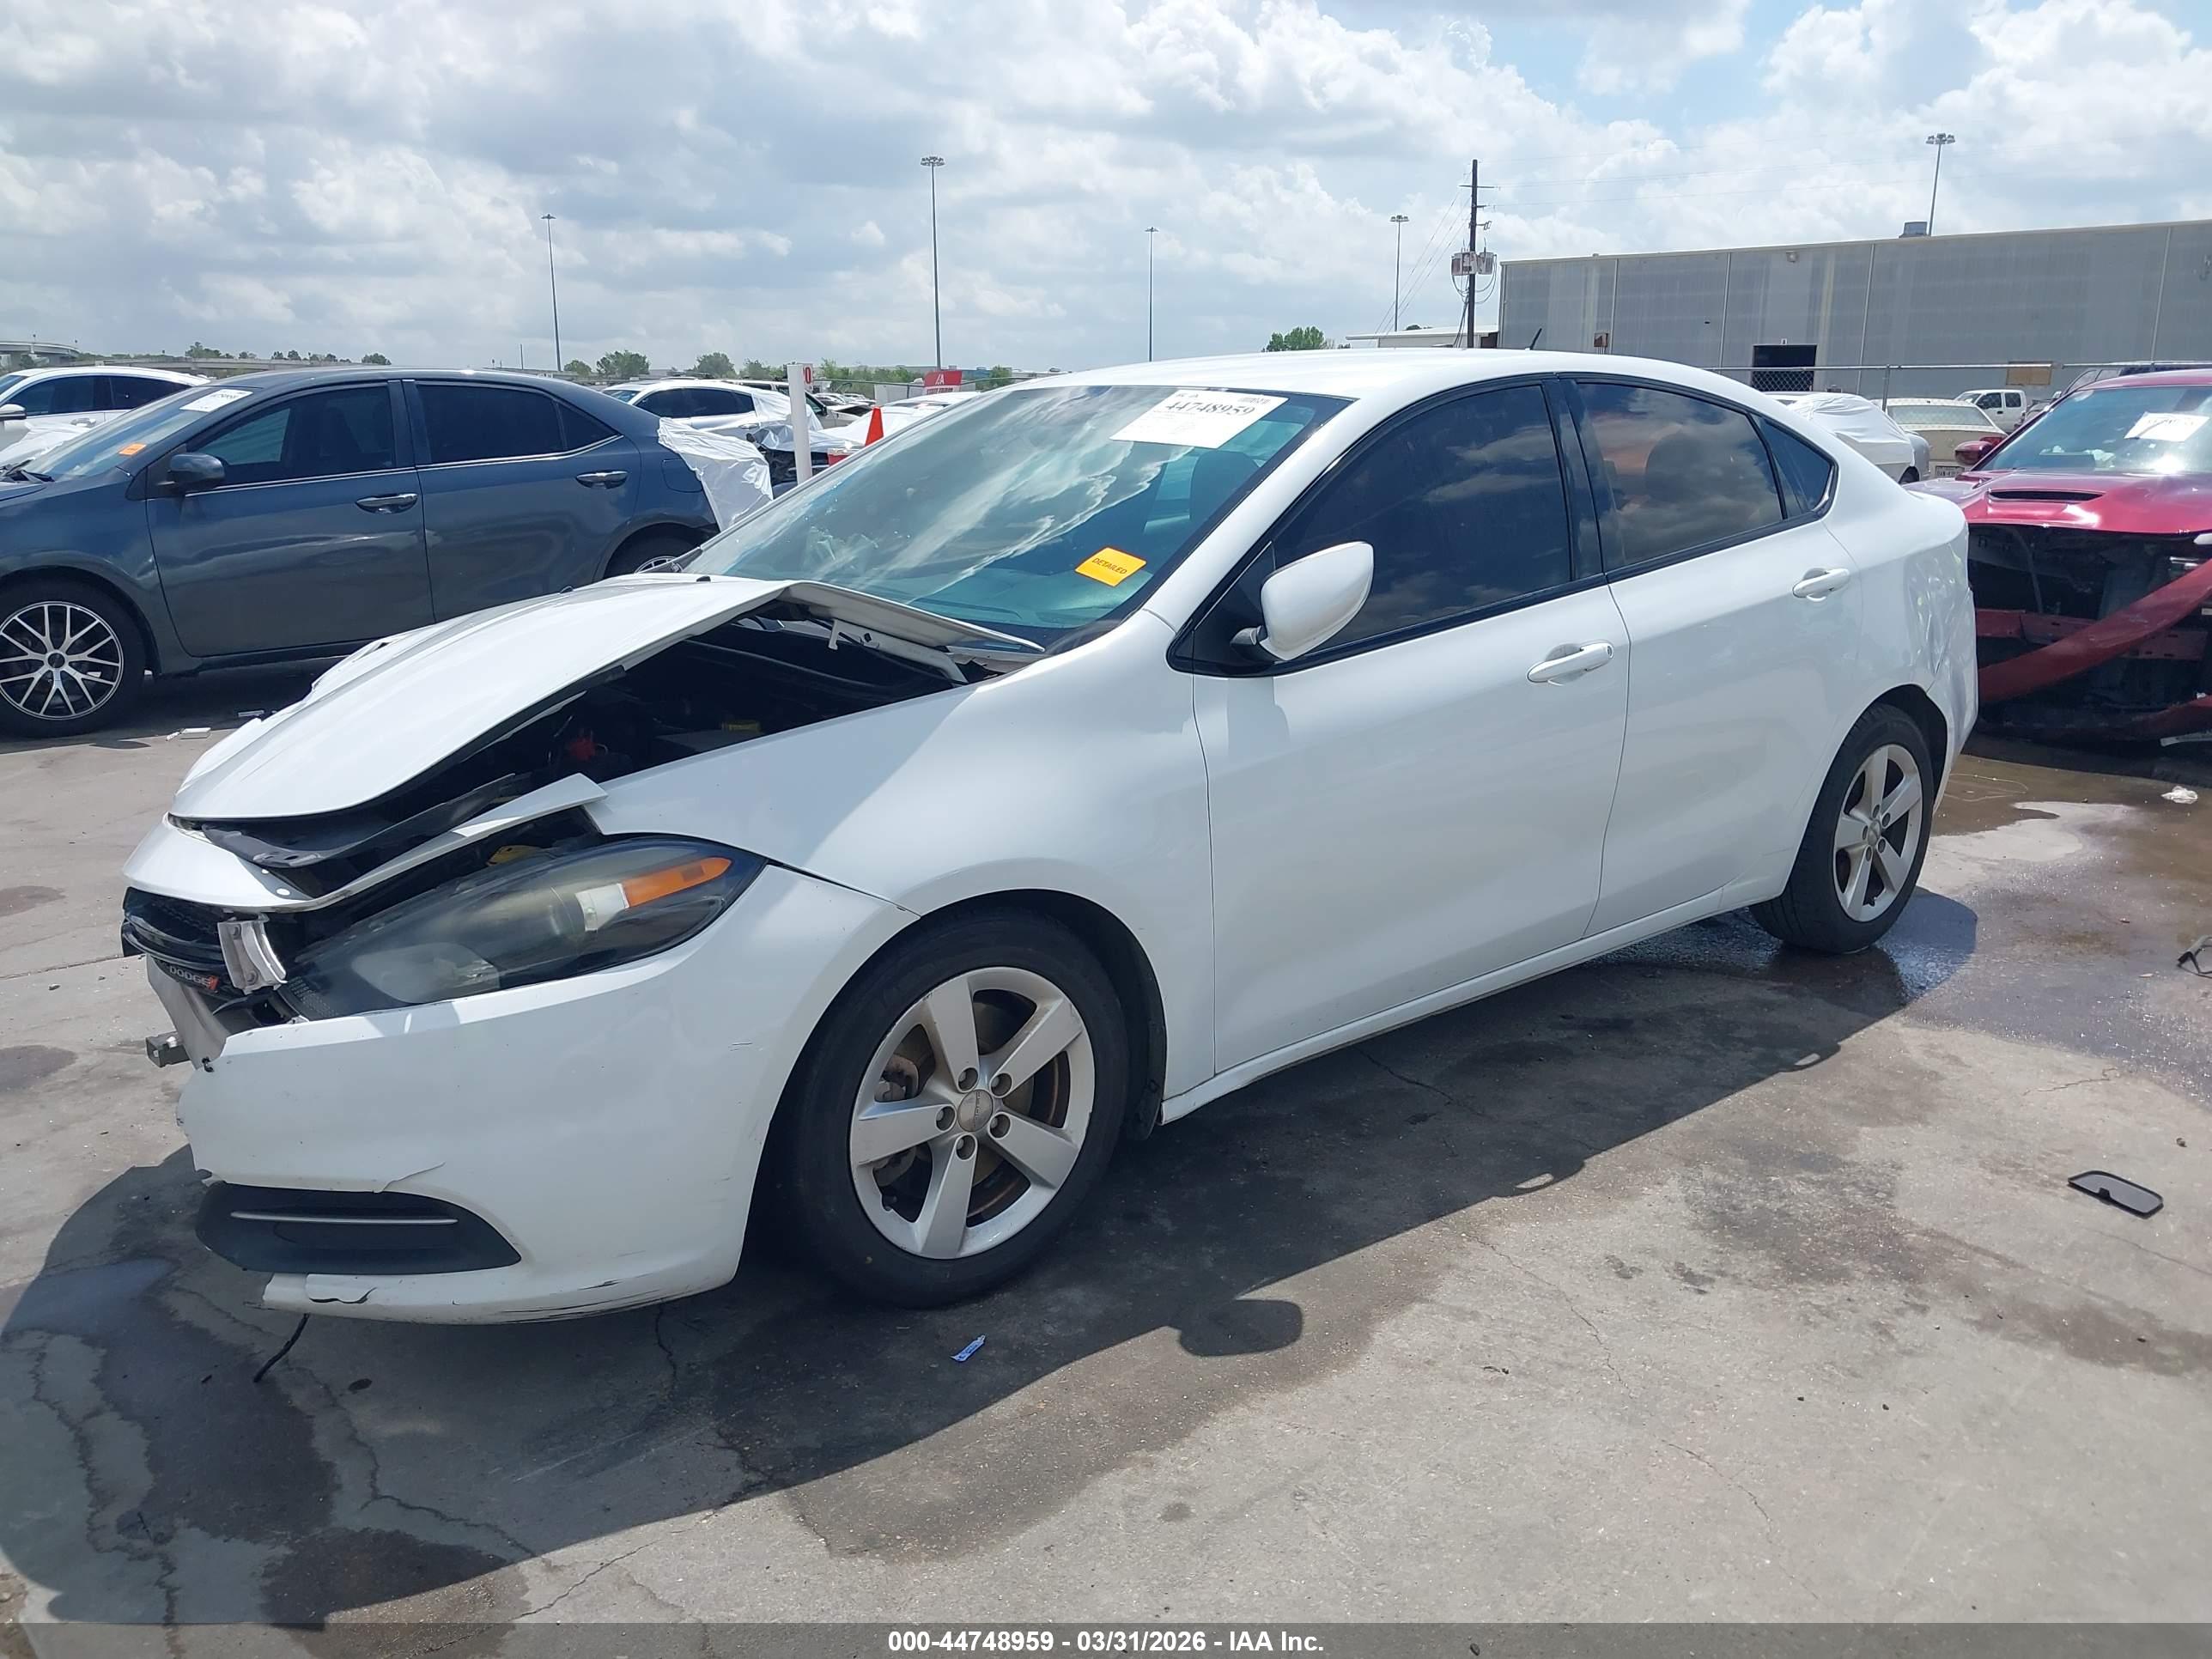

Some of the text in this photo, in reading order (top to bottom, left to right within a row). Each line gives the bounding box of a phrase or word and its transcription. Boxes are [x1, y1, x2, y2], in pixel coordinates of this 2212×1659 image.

[1165, 401, 1255, 416] 44748959
[1091, 557, 1127, 574] DETAILED
[169, 965, 211, 988] DODGE
